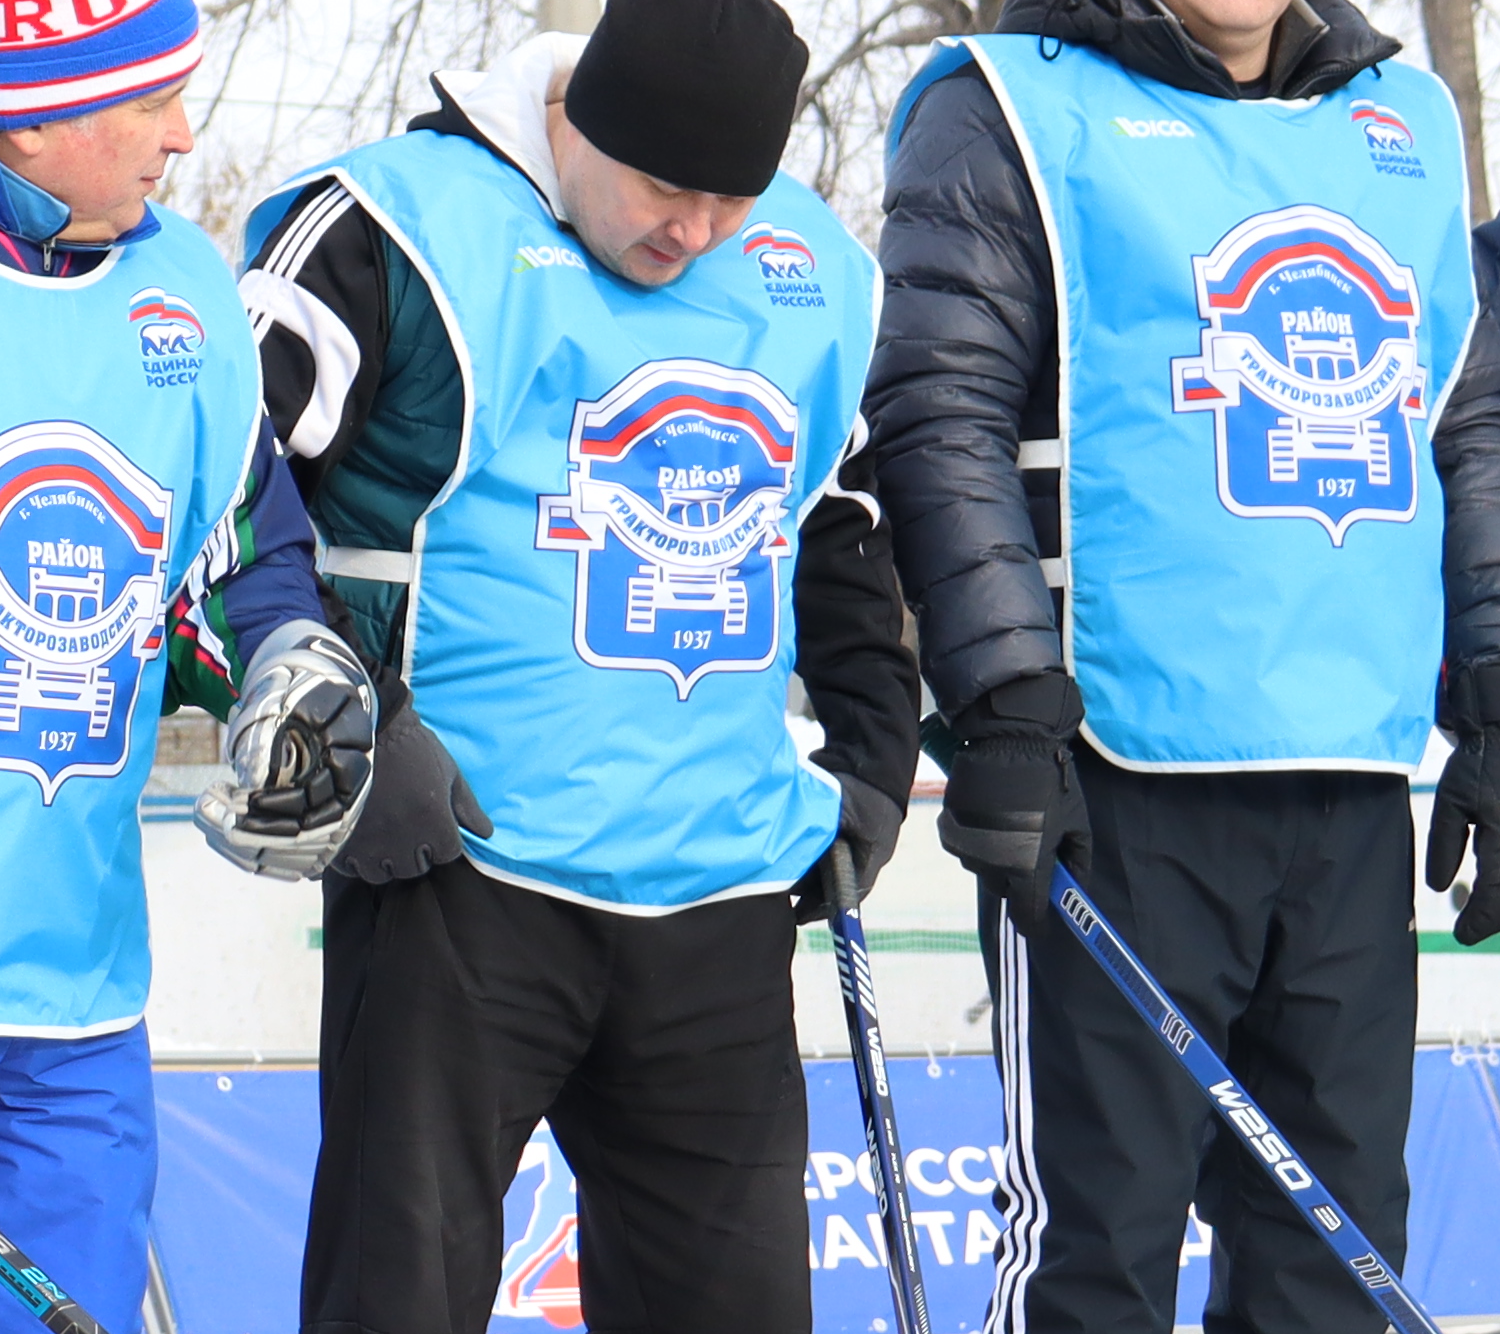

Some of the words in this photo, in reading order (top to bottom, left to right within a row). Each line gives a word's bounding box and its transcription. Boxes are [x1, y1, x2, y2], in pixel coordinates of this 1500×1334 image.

[1370, 151, 1421, 167] ЕДИНАЯ
[1376, 164, 1427, 179] РОССИЯ
[764, 282, 823, 296] ЕДИНАЯ
[1280, 263, 1353, 295] Челябинск
[770, 294, 826, 308] РОССИЯ
[1281, 306, 1353, 335] РАЙОН
[1239, 347, 1402, 410] ТРАКТОРОЗАВОДСКИЙ
[657, 462, 741, 491] РАЙОН
[1316, 478, 1357, 499] 1937
[31, 489, 107, 526] Челябинск
[27, 536, 105, 571] РАЙОН
[672, 628, 713, 651] 1937
[37, 729, 78, 752] 1937
[864, 1025, 890, 1098] W250
[1207, 1077, 1314, 1192] W250
[865, 1116, 890, 1220] W250
